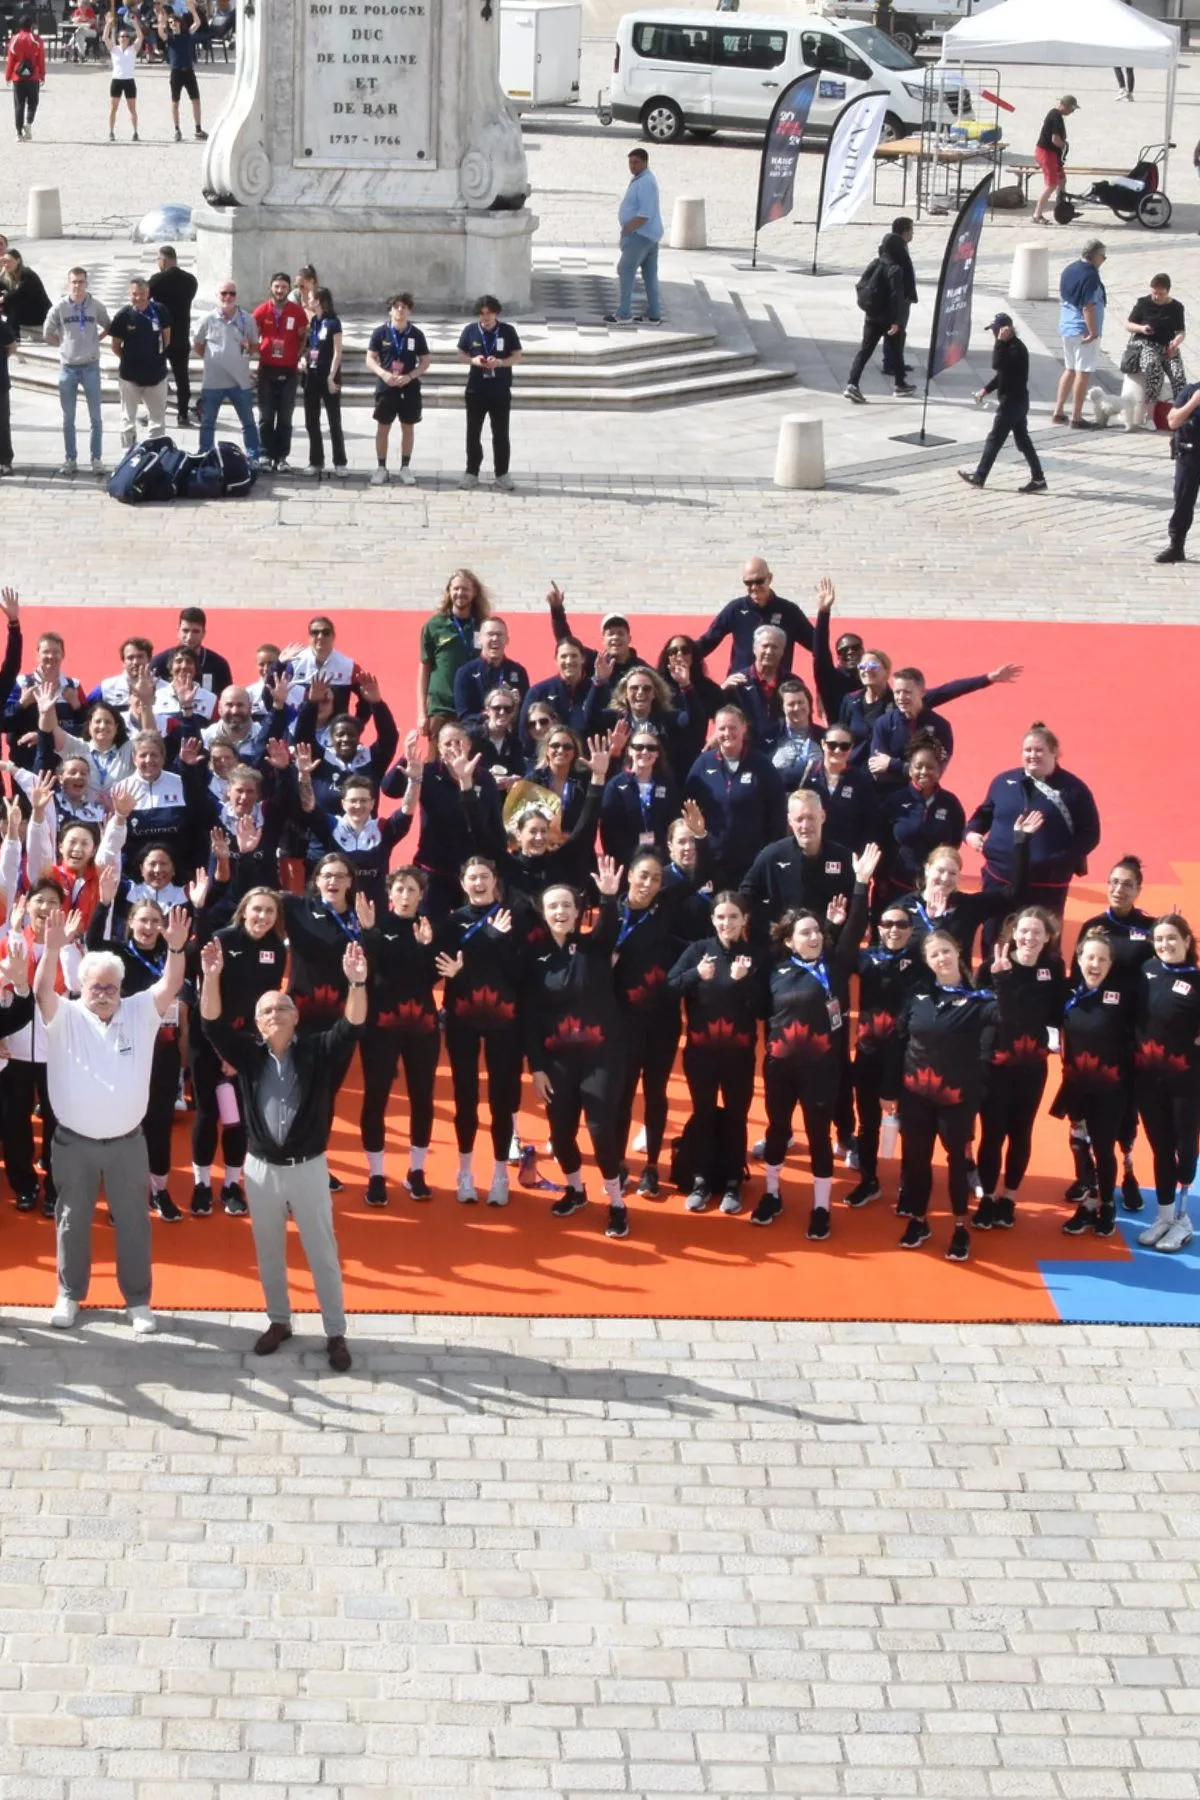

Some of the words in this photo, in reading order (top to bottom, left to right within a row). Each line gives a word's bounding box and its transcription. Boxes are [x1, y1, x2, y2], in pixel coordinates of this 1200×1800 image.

[310, 5, 332, 15] ROI
[339, 5, 358, 15] DE
[364, 5, 426, 16] POLOGNE
[351, 28, 384, 41] DUC
[317, 53, 335, 64] DE
[343, 53, 417, 65] LORRAINE
[355, 77, 377, 89] ET
[333, 102, 354, 114] DE
[363, 103, 398, 115] BAR
[374, 135, 401, 146] 1766
